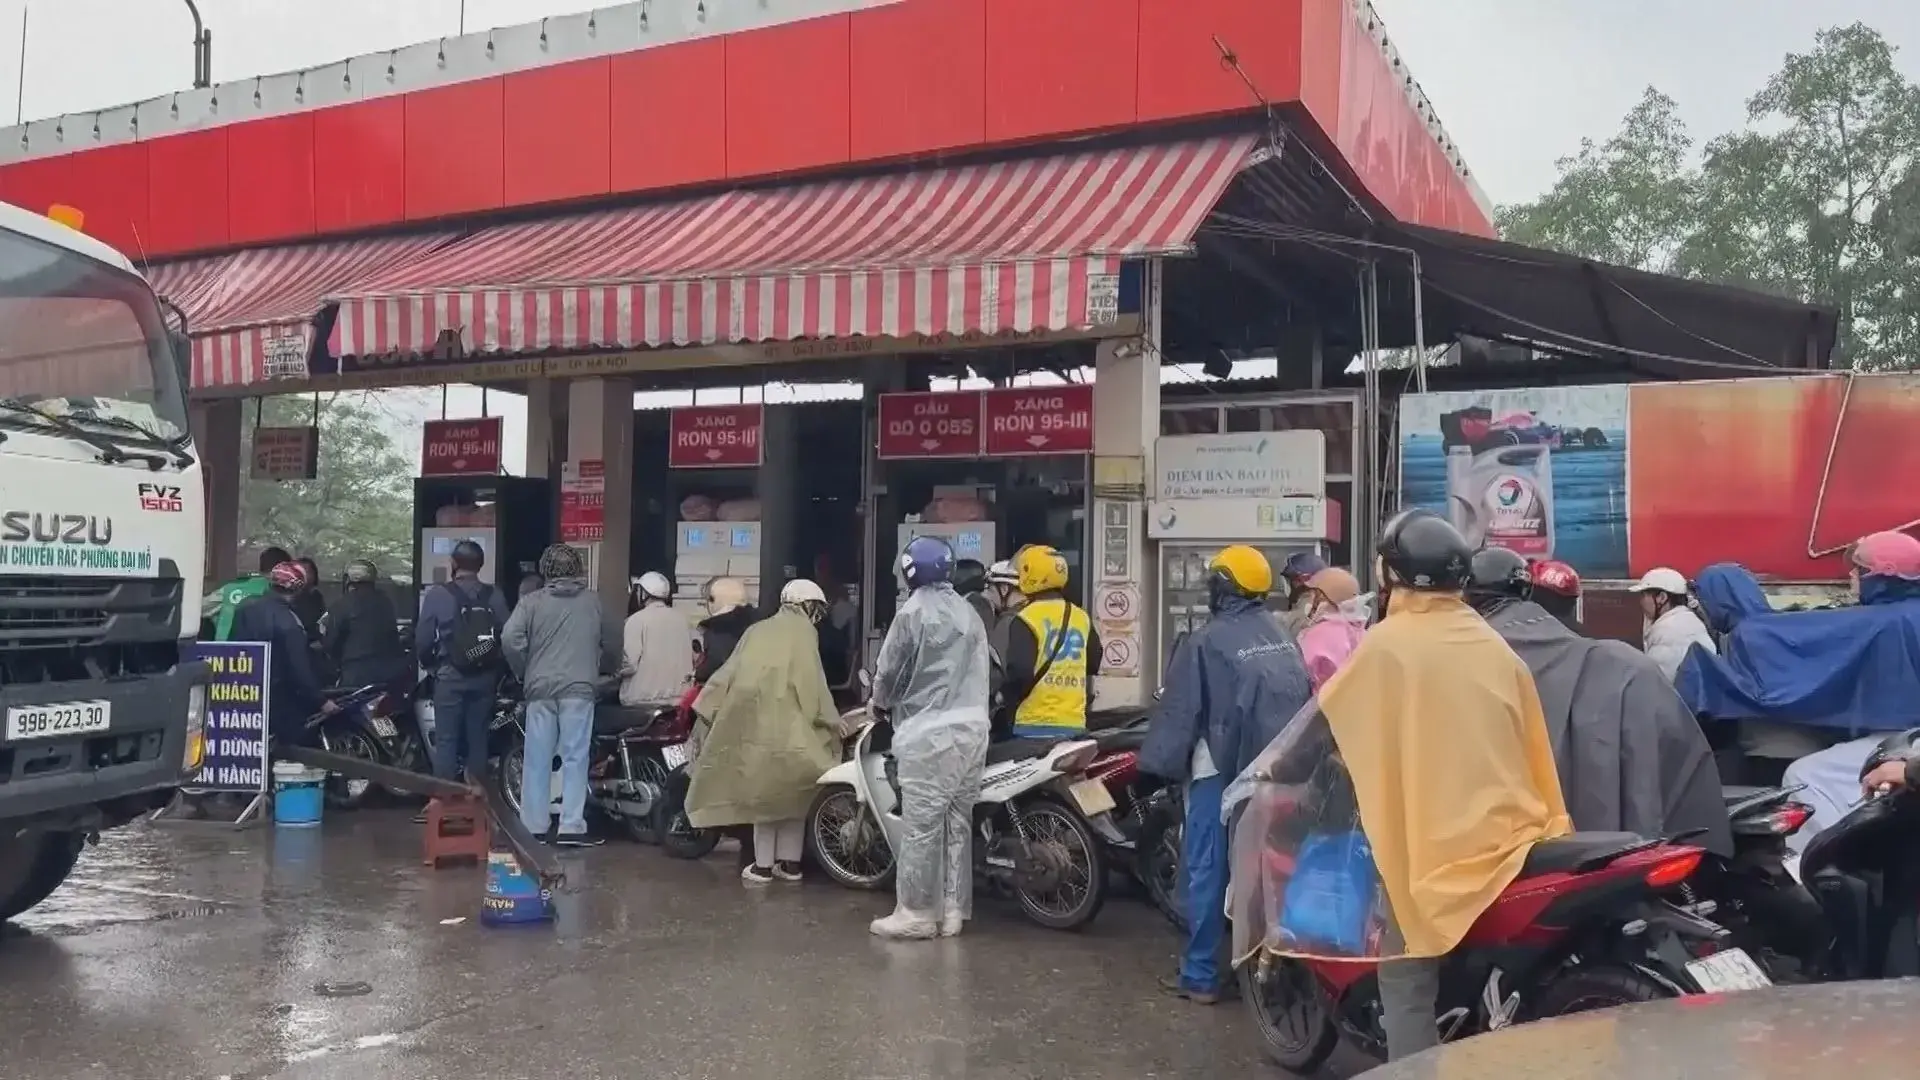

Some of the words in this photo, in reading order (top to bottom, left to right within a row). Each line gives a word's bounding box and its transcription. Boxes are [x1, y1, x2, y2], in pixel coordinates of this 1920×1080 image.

[994, 415, 1034, 432] RON
[1041, 411, 1088, 430] 95-III
[429, 441, 458, 457] RON
[678, 430, 712, 447] RON
[138, 483, 182, 500] FVZ
[140, 497, 183, 512] 1500
[58, 545, 78, 568] RÁC
[228, 650, 253, 674] LỖI
[211, 681, 260, 701] KHÁCH
[220, 708, 262, 730] HÀNG
[220, 736, 262, 757] DỪNG
[218, 763, 261, 785] HÀNG
